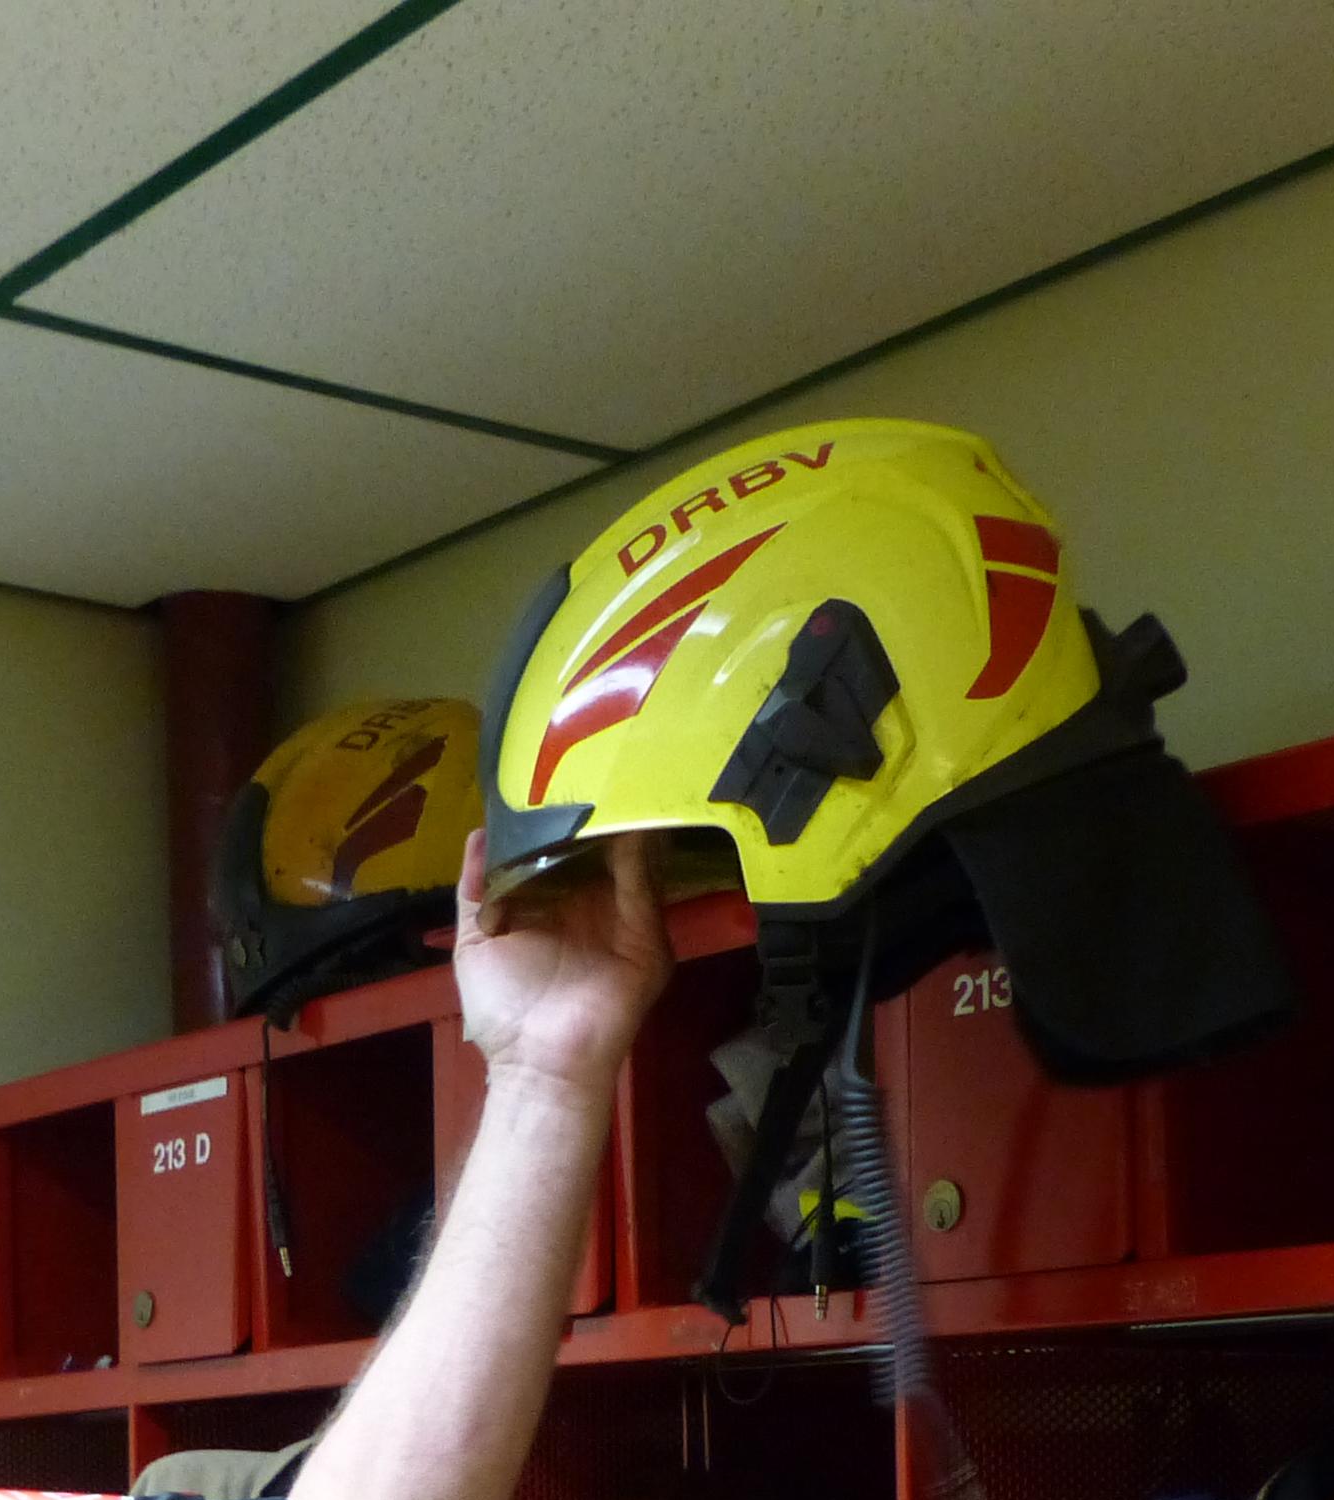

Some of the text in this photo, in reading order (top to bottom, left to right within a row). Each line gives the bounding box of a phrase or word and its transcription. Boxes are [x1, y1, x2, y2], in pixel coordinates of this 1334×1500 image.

[617, 442, 834, 577] DRBV
[953, 967, 1012, 1017] 213
[154, 1132, 210, 1174] 213 D
